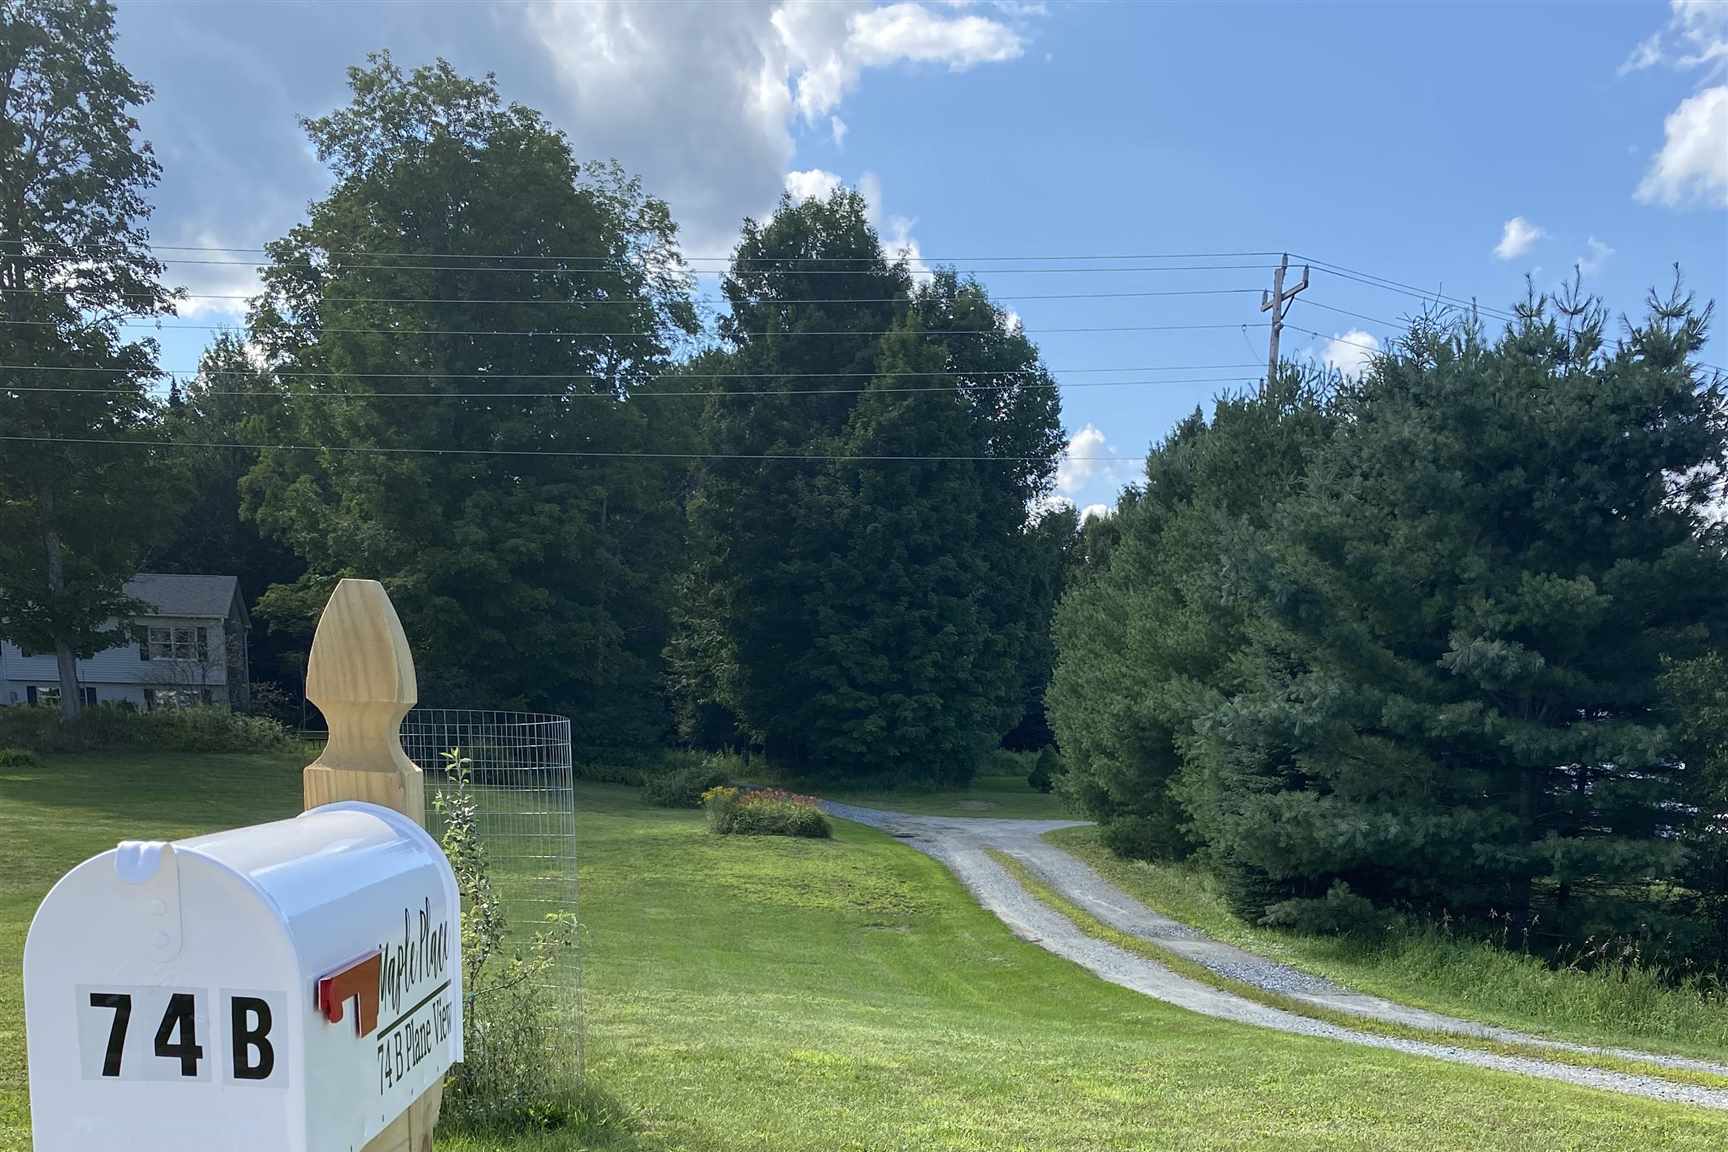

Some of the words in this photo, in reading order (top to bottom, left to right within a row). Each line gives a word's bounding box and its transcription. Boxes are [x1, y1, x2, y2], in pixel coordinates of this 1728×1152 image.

[419, 896, 449, 983] Place
[89, 992, 204, 1077] 74
[231, 995, 276, 1080] B
[377, 1039, 393, 1096] 74
[394, 1029, 404, 1082] B
[404, 1019, 431, 1073] Plane
[432, 998, 453, 1044] View
